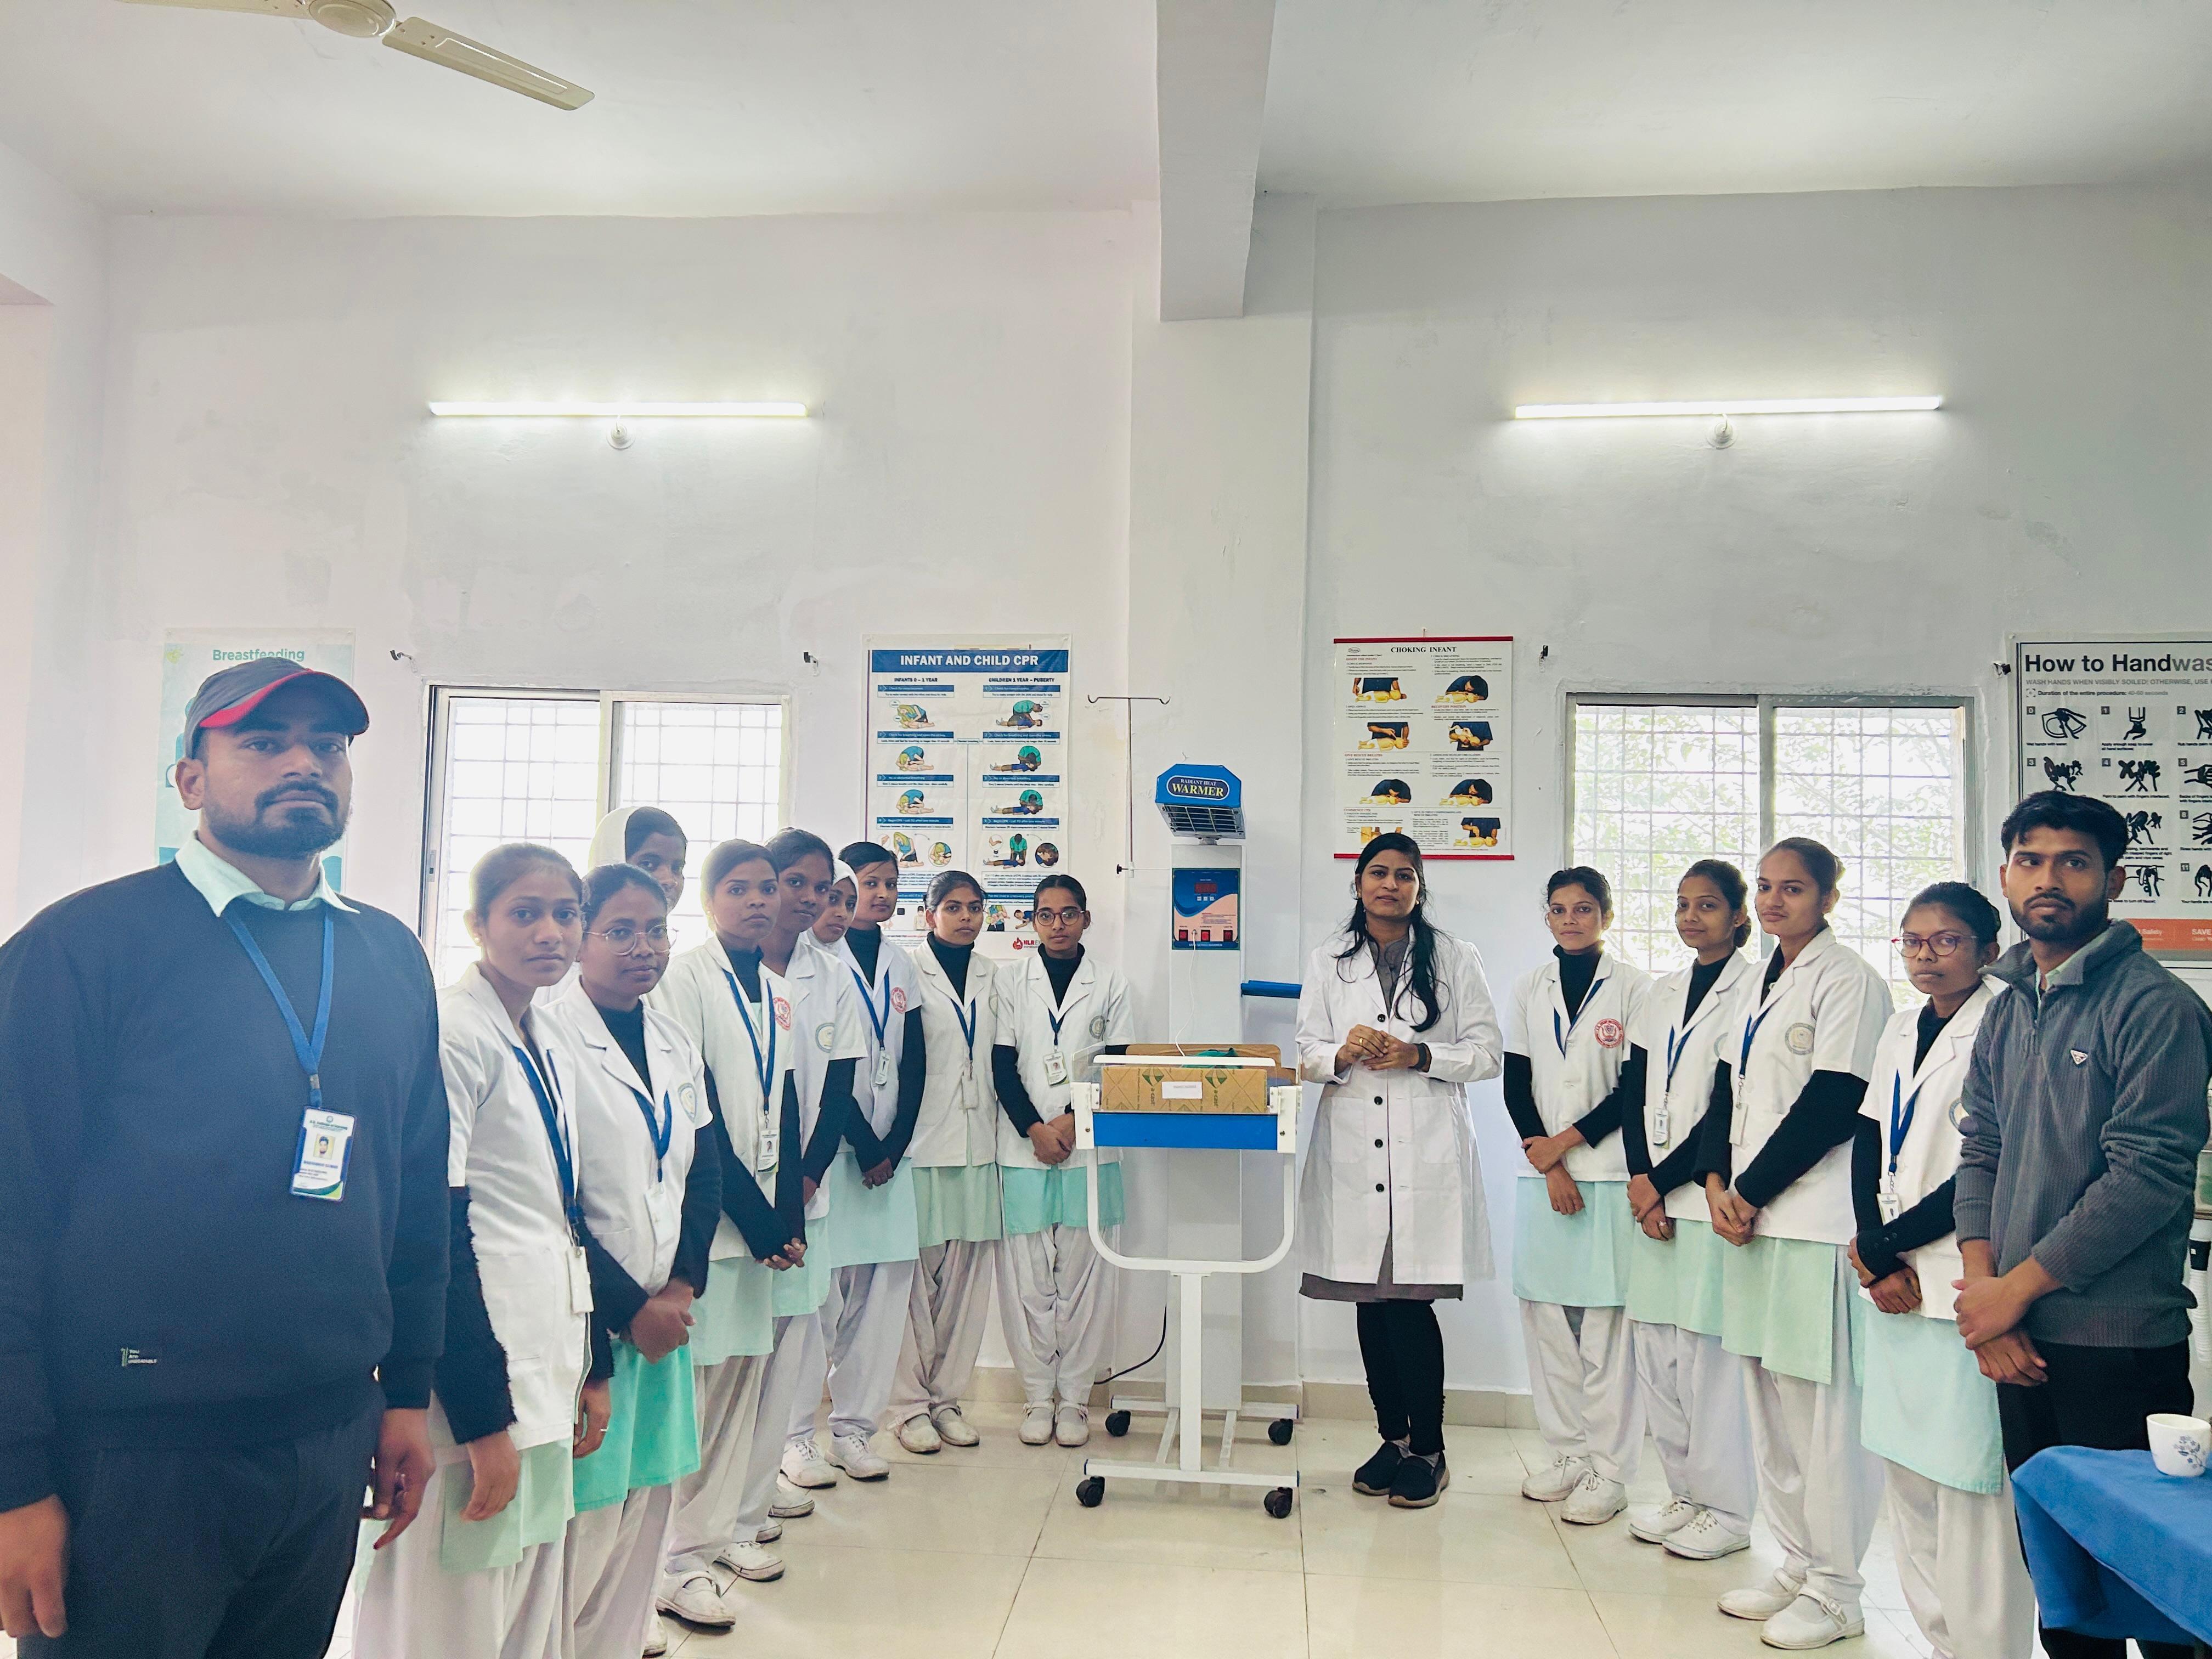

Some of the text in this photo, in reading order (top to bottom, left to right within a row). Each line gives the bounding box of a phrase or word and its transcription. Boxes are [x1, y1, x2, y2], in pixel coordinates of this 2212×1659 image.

[900, 655, 1039, 665] INFANT AND CHILD CPR
[2025, 654, 2075, 672] How
[2081, 655, 2103, 672] to
[1172, 783, 1224, 797] WARMER
